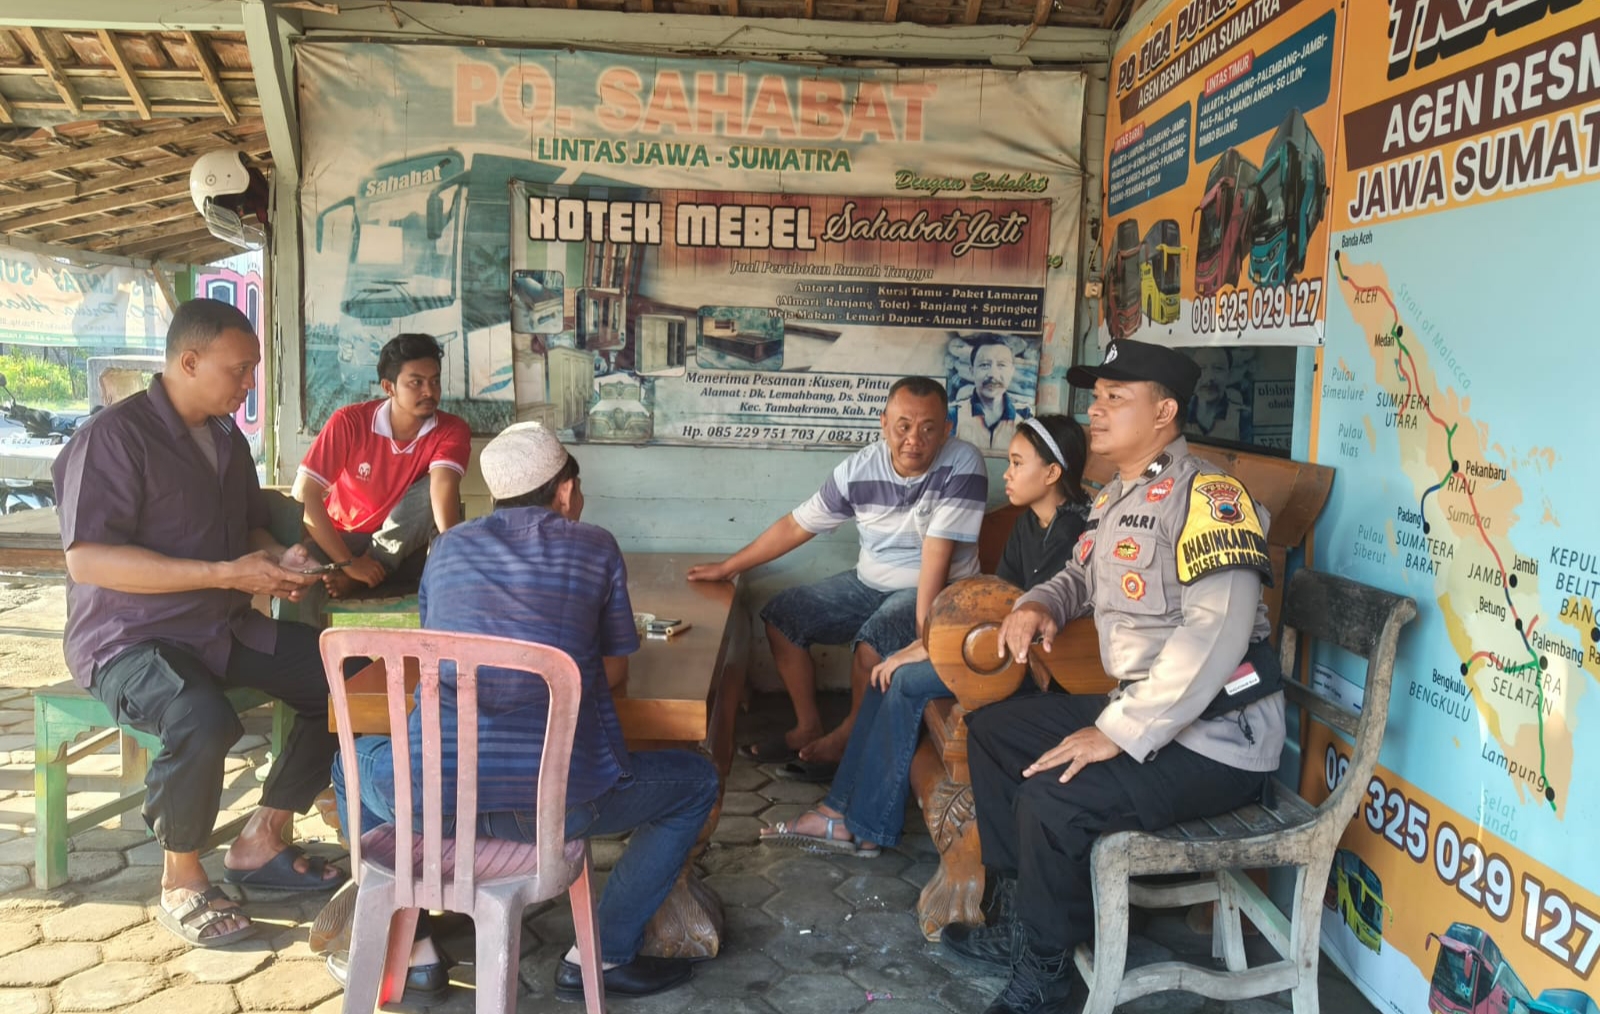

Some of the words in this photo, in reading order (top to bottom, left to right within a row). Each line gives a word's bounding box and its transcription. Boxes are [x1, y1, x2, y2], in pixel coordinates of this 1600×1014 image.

[1116, 52, 1137, 97] PO
[1138, 23, 1172, 80] TIGA
[1138, 81, 1159, 110] AGEN
[1159, 60, 1185, 93] RESMI
[1187, 33, 1218, 74] JAWA
[1219, 0, 1281, 50] SUMATRA
[1206, 67, 1228, 94] LINTAS
[1228, 54, 1250, 81] TIMUR
[452, 63, 572, 129] PO.
[597, 66, 937, 142] SAHABAT
[1382, 73, 1484, 153] AGEN
[537, 137, 629, 164] LINTAS
[635, 141, 711, 167] JAWA
[727, 146, 852, 173] SUMATRA
[1348, 147, 1448, 224] JAWA
[1452, 104, 1600, 201] SUMAT
[895, 169, 966, 196] Dengan
[970, 171, 1049, 193] Sahabat
[527, 196, 664, 246] KOTEK
[675, 202, 817, 251] MEBEL
[821, 200, 971, 244] Sahabat
[951, 208, 1029, 258] Jati
[1341, 233, 1358, 248] Banda
[1359, 230, 1373, 245] Aceh
[730, 260, 760, 275] Jual
[761, 261, 832, 276] Perabotan
[832, 263, 882, 278] Rumah
[883, 264, 935, 281] Tangga
[795, 282, 835, 295] Antara
[838, 284, 864, 295] Lain
[877, 286, 908, 297] Kursi
[910, 287, 943, 298] Tamu
[952, 288, 985, 300] Paket
[986, 289, 1039, 301] Lamaran
[1353, 287, 1378, 304] ACEH
[919, 301, 968, 314] Ranjang
[1191, 294, 1217, 334] 081
[1218, 286, 1249, 333] 325
[1250, 283, 1286, 329] 029
[1288, 277, 1323, 327] 127
[767, 309, 795, 321] Meja
[797, 310, 836, 321] Makan
[845, 312, 885, 323] Lemari
[888, 313, 923, 326] Dapur
[932, 315, 972, 326] Almari
[981, 316, 1012, 328] Bufet
[1020, 317, 1037, 329] dll
[1374, 333, 1395, 347] Medan
[685, 371, 750, 386] Menerima
[752, 373, 806, 387] Pesanan
[856, 378, 890, 390] Pintu
[1331, 367, 1356, 382] Pulau
[700, 387, 741, 398] Alamat
[749, 388, 767, 399] Dk.
[768, 388, 836, 402] Lemahbang,
[838, 391, 855, 402] Ds.
[1375, 392, 1430, 410] SUMATERA
[740, 402, 762, 412] Kec.
[764, 402, 840, 415] Tambakromo,
[842, 404, 866, 416] Kab.
[1385, 412, 1418, 430] UTARA
[682, 425, 703, 439] Hp.
[706, 426, 732, 438] 085
[734, 426, 760, 438] 229
[763, 427, 786, 439] 751
[791, 429, 815, 441] 703
[827, 430, 853, 442] 082
[854, 430, 881, 443] 313
[1337, 423, 1363, 440] Pulau
[1339, 441, 1359, 458] Nias
[1465, 459, 1507, 482] Pekanbaru
[1447, 476, 1477, 496] RIAU
[1118, 514, 1156, 530] POLRI
[1397, 506, 1421, 529] Padang
[1446, 505, 1492, 530] Sumatra
[1357, 524, 1384, 545] Pulau
[1395, 530, 1455, 559] SUMATERA
[1352, 542, 1387, 565] Siberut
[1404, 553, 1441, 577] BARAT
[1512, 554, 1539, 577] Jambi
[1187, 552, 1222, 580] POLSEK
[1467, 562, 1508, 589] JAMBI
[1479, 595, 1506, 623] Betung
[1531, 630, 1584, 669] Palembang
[1432, 668, 1466, 698] Bengkulu
[1486, 651, 1562, 696] SUMATERA
[1408, 681, 1471, 723] BENGKULU
[1490, 676, 1554, 717] SELATAN
[1481, 742, 1547, 793] Lampung
[1483, 788, 1516, 821] Selat
[1365, 776, 1429, 863] 325
[1434, 821, 1515, 923] 029
[1521, 870, 1600, 981] 127
